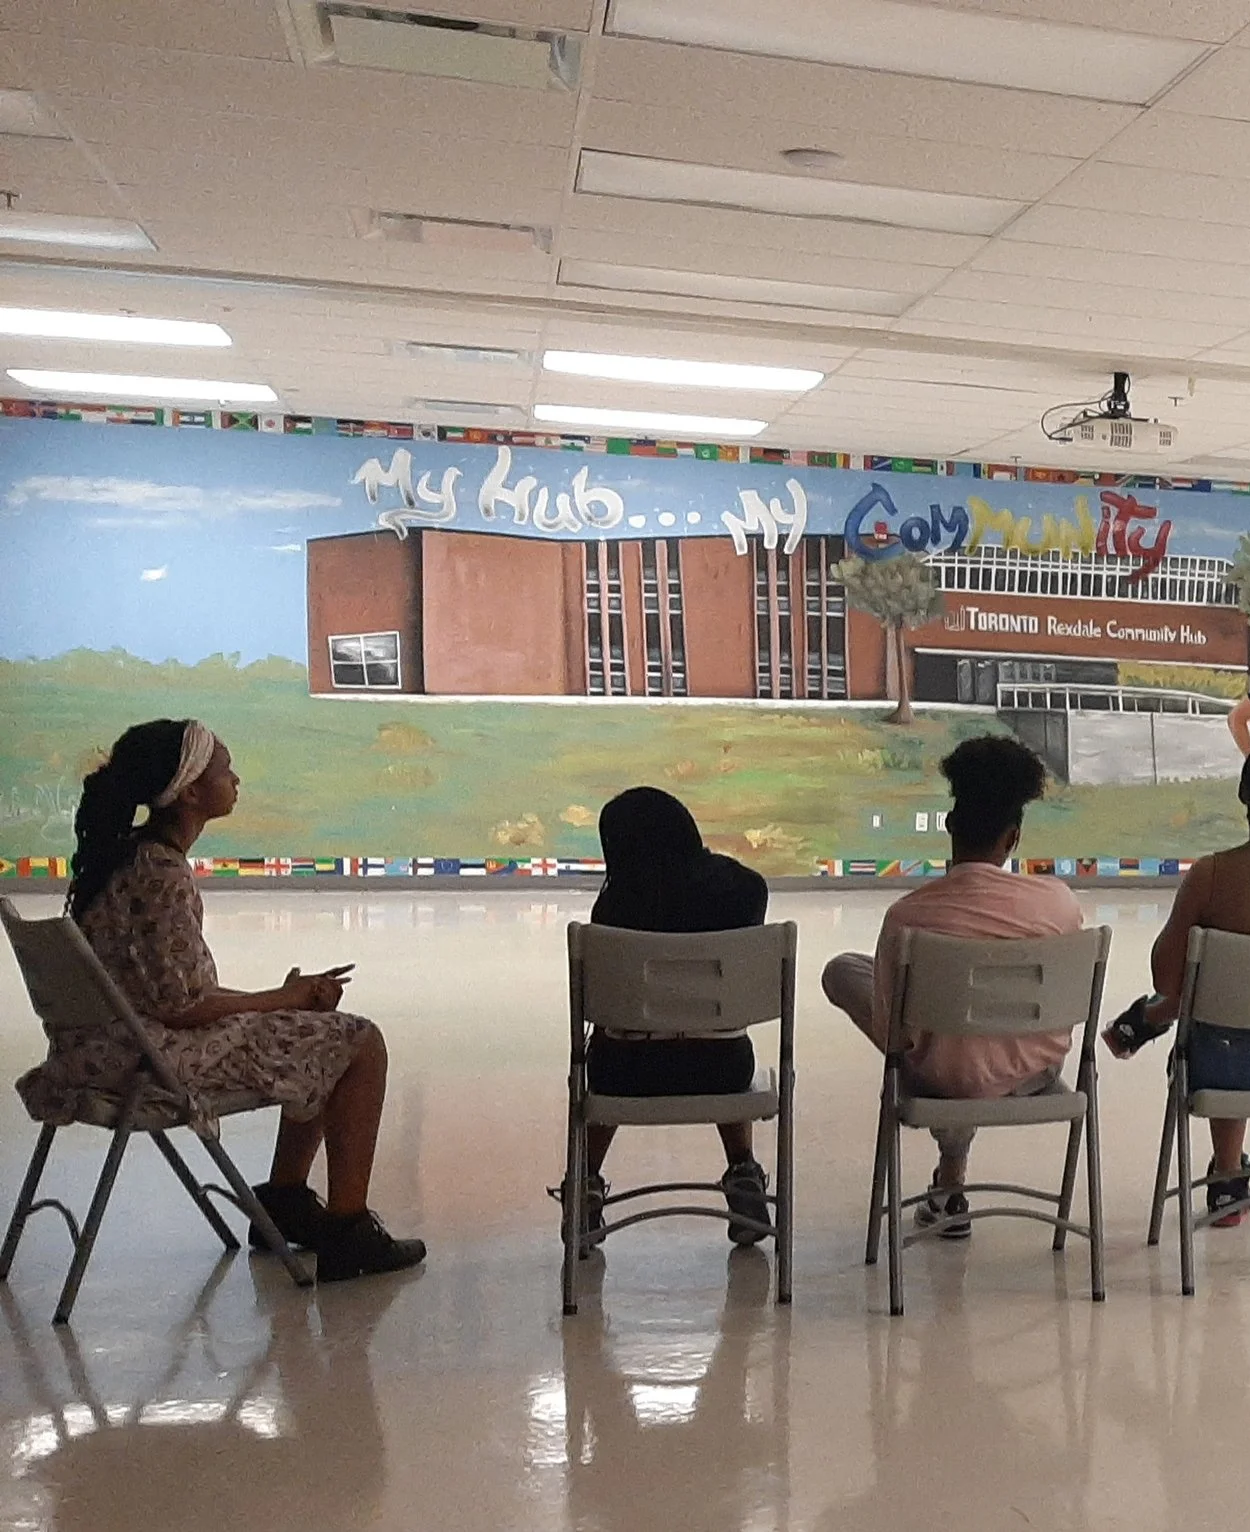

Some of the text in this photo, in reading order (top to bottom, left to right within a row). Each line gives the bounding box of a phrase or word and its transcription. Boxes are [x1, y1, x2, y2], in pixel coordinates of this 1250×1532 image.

[965, 606, 1208, 646] TORONTO Rexdale Community Hub
